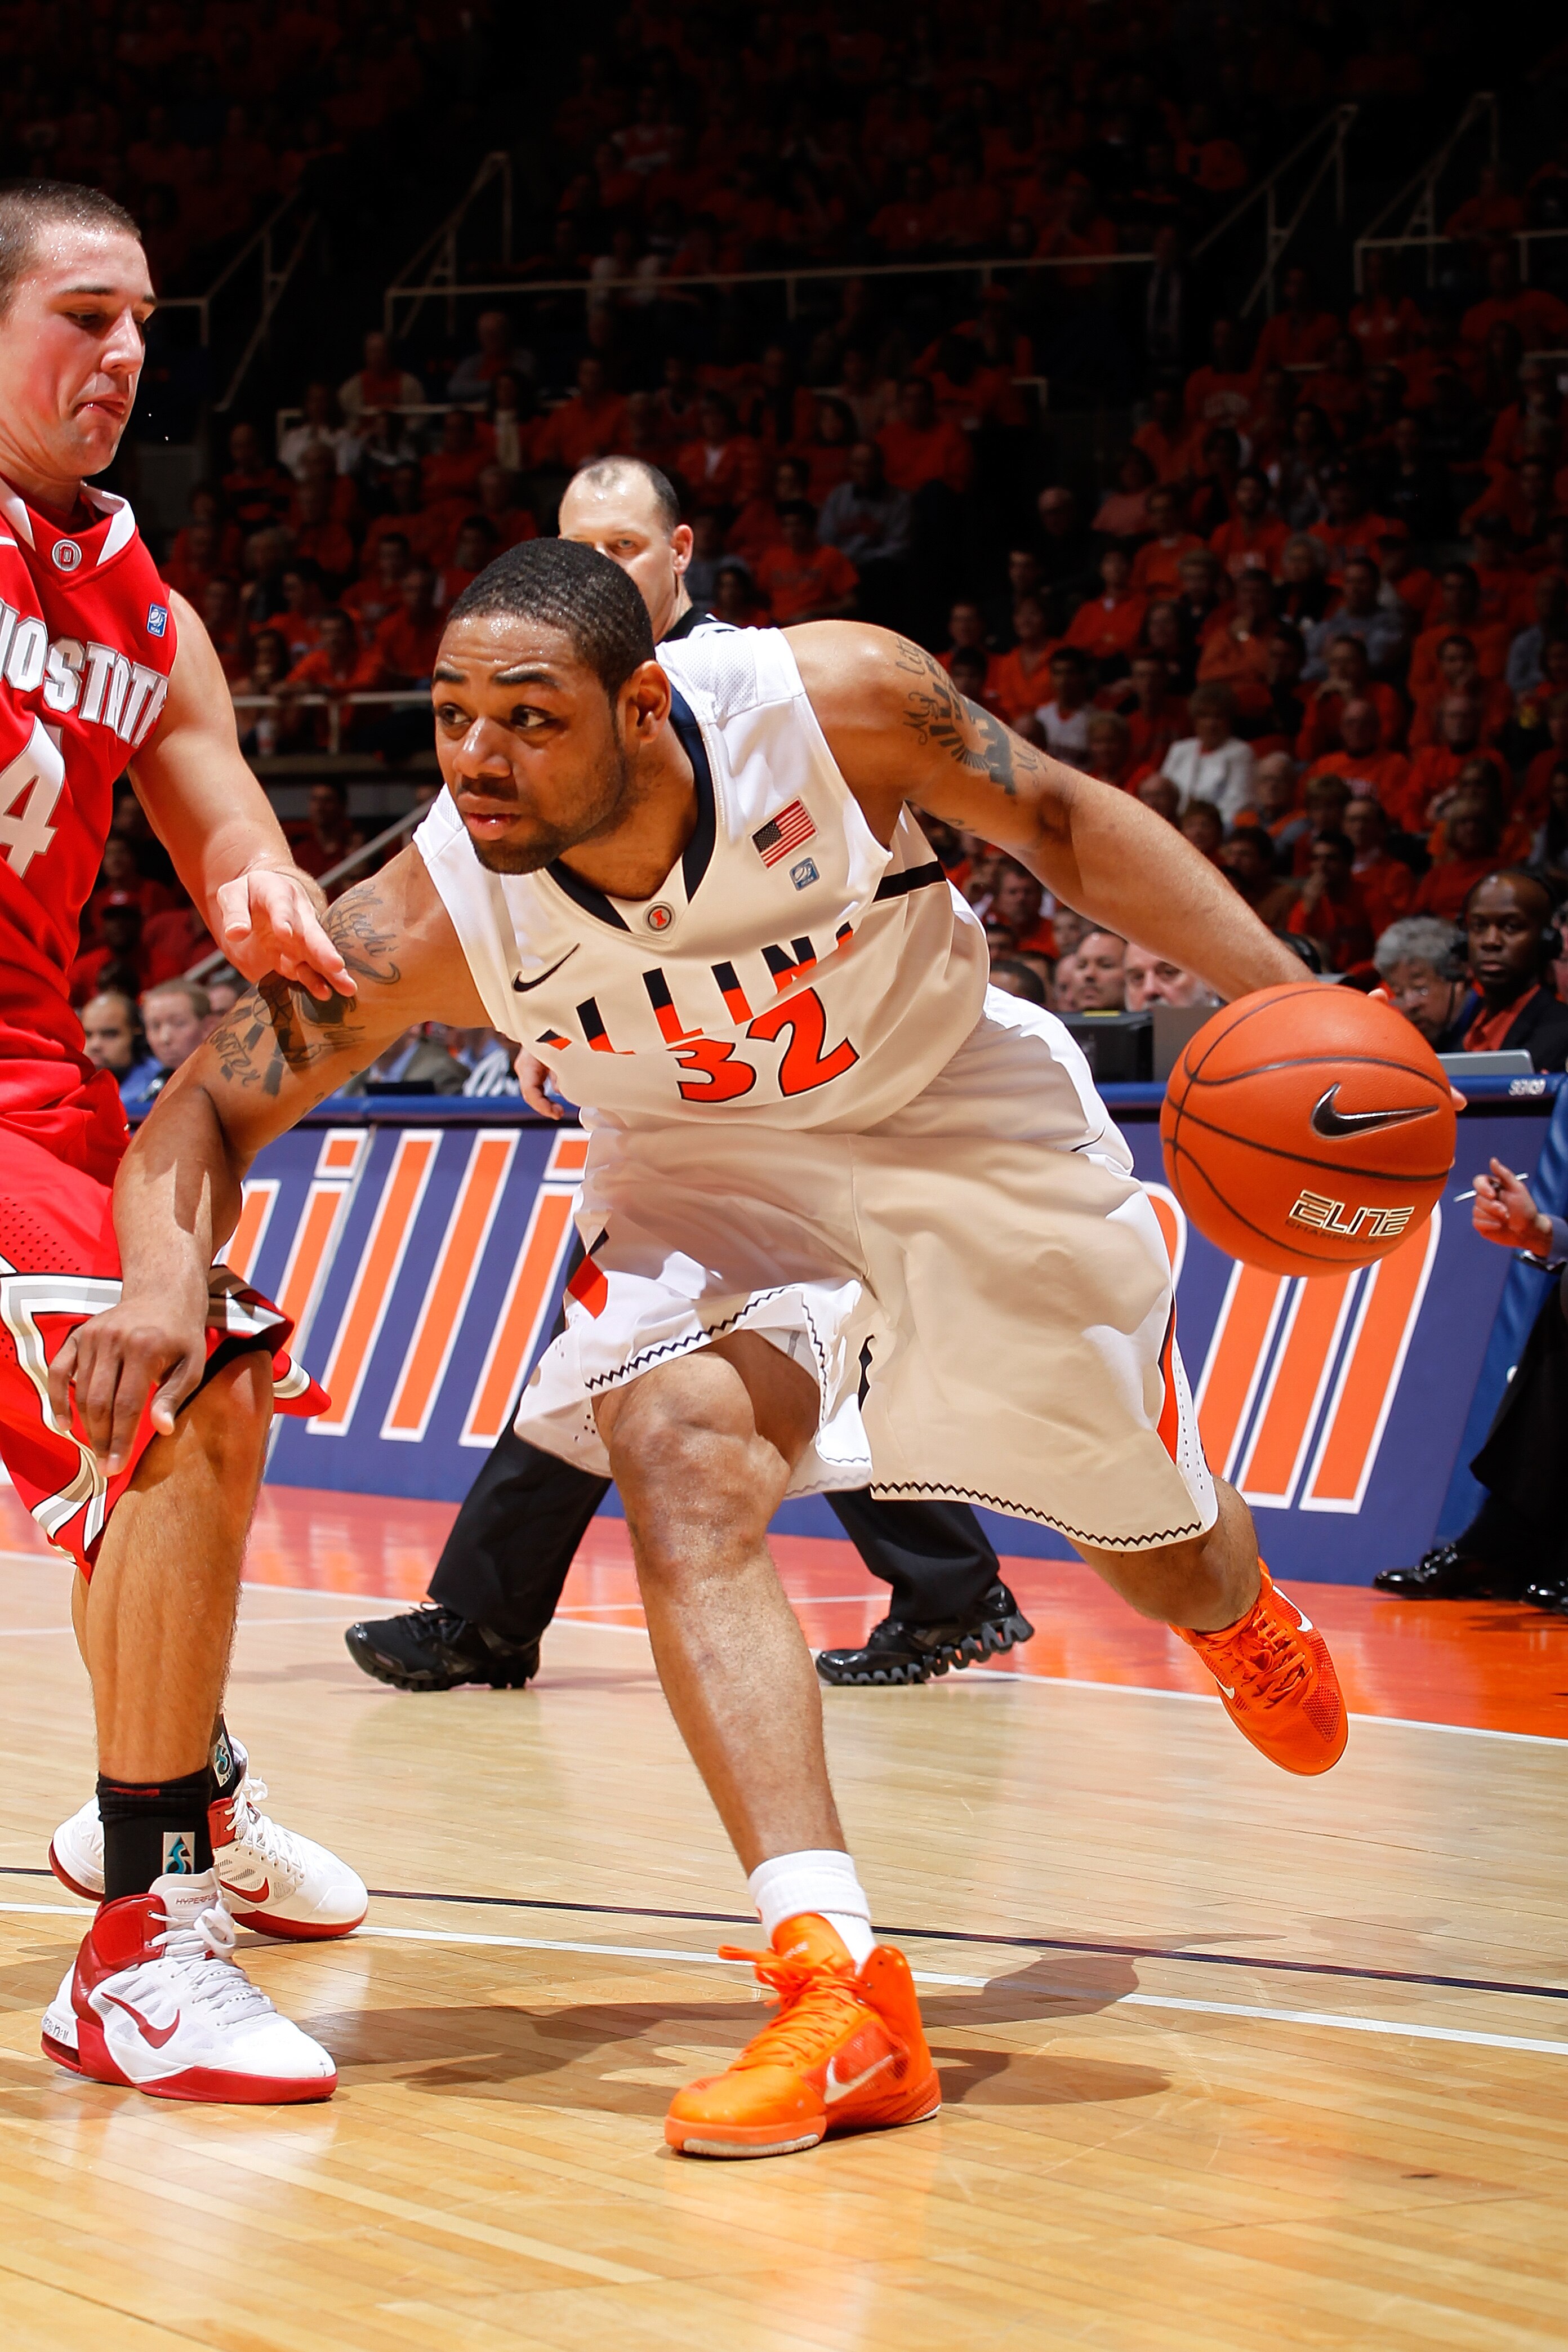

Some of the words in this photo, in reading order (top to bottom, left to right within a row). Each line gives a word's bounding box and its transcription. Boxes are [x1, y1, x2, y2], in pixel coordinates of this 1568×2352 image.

[0, 596, 48, 693] IO
[0, 715, 65, 880] 4
[665, 987, 861, 1103] 32
[1289, 1189, 1416, 1237] ELITE
